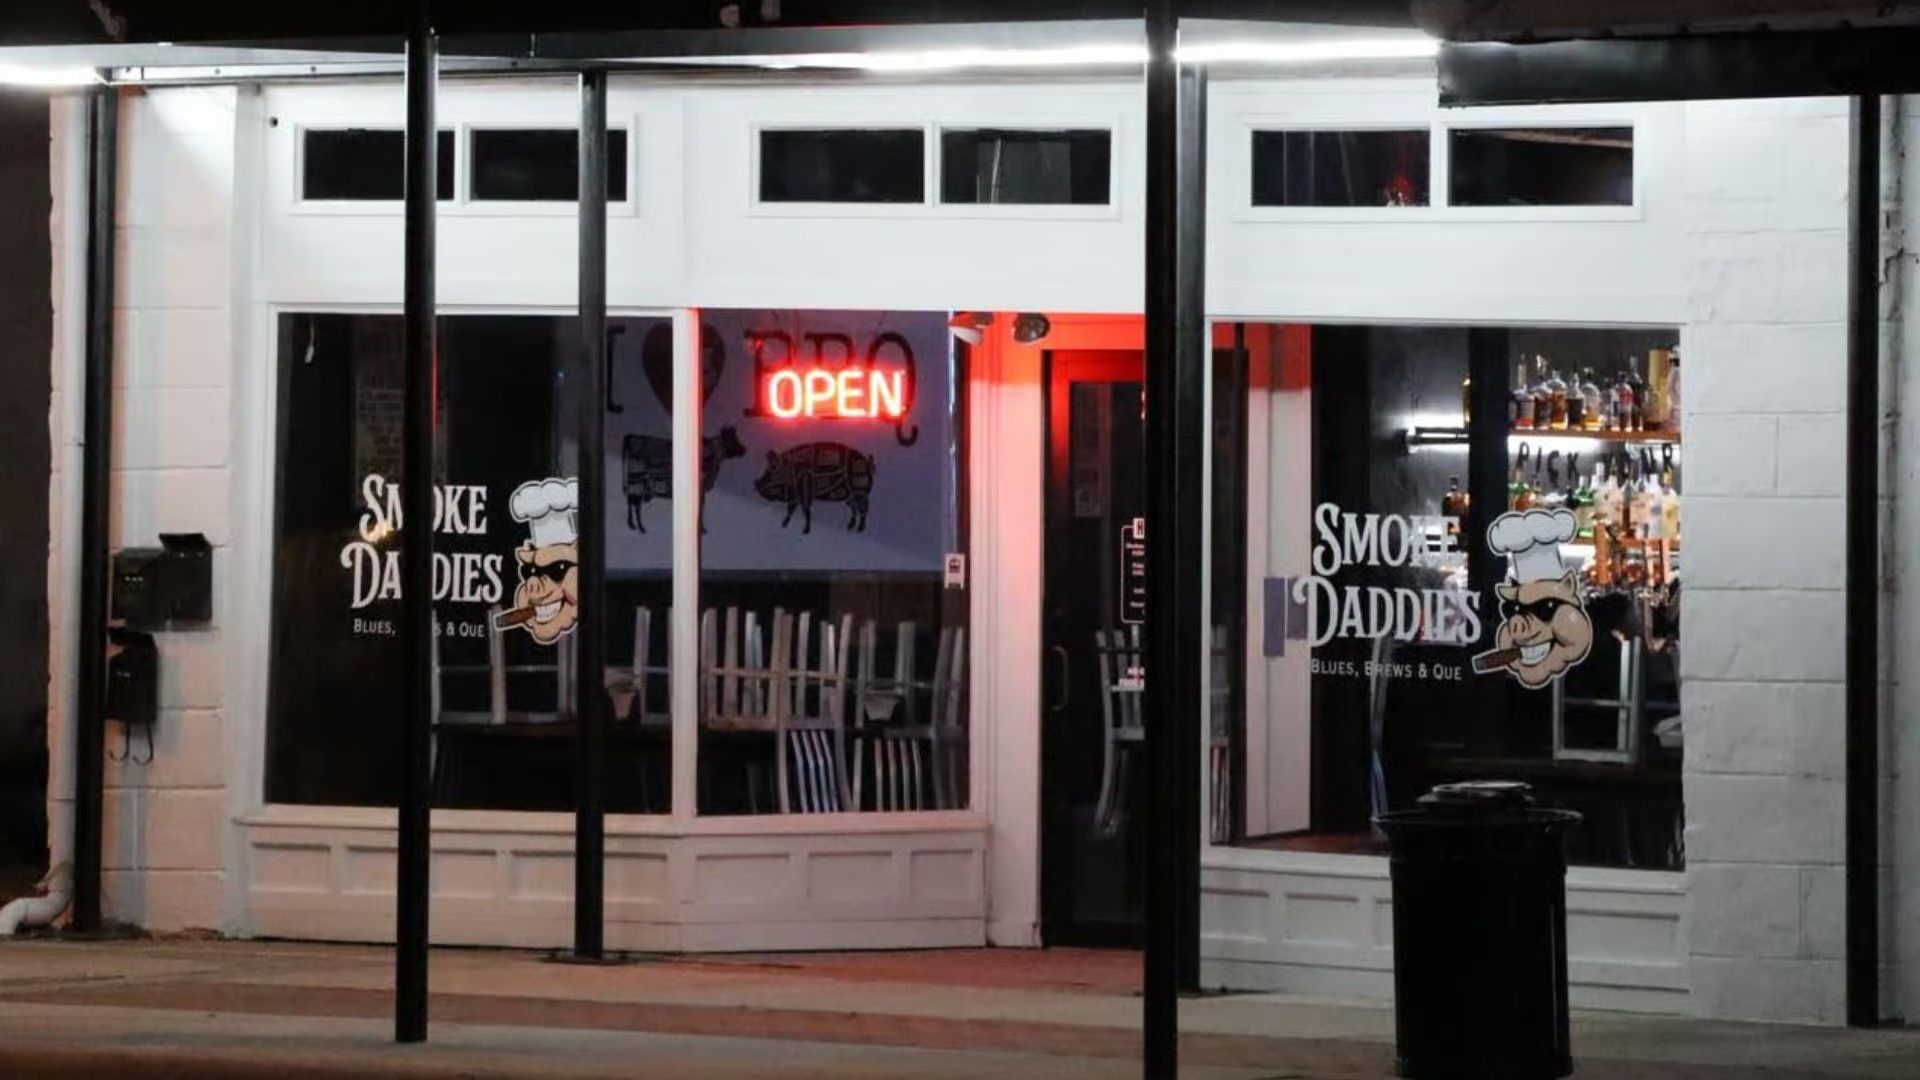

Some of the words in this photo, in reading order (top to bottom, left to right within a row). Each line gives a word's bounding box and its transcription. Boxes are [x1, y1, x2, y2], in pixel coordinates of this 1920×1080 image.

[767, 367, 904, 419] OPEN
[1313, 502, 1460, 576] SMOKE
[340, 541, 504, 608] DADIES
[353, 617, 396, 638] BLUES,
[446, 621, 455, 636] &
[459, 621, 485, 638] QUE
[1293, 574, 1481, 647] DADDIES
[1310, 657, 1360, 678] BLUES,
[1364, 660, 1413, 679] BREWS
[1418, 663, 1429, 679] &
[1432, 662, 1463, 681] QUE
